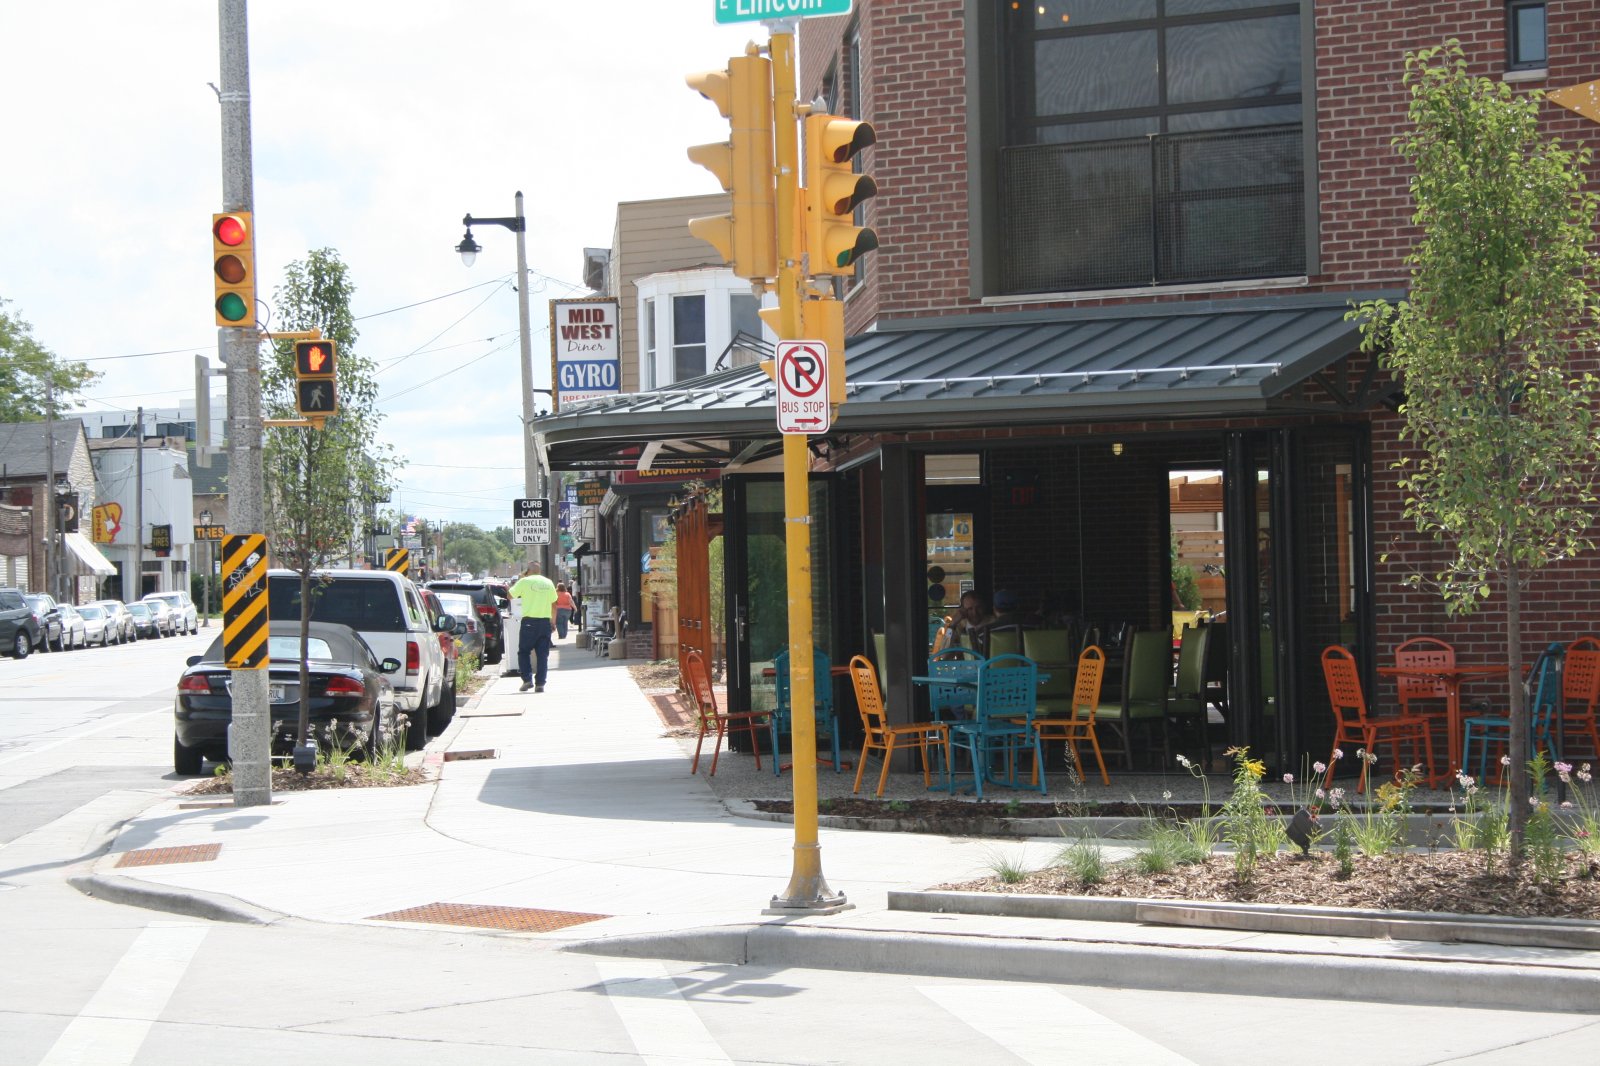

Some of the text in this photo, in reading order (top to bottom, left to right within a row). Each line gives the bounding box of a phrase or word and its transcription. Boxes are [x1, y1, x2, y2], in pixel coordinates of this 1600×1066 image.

[568, 308, 605, 324] MID
[560, 324, 613, 340] WEST
[567, 340, 605, 352] Diner
[560, 363, 616, 388] GYRO
[782, 401, 825, 413] BUS STOP
[639, 468, 706, 476] RESTA
[521, 500, 543, 509] CURB
[521, 510, 543, 518] LANE
[516, 519, 547, 527] BICYCLES
[196, 527, 225, 538] TIRES
[523, 527, 547, 535] PARKING
